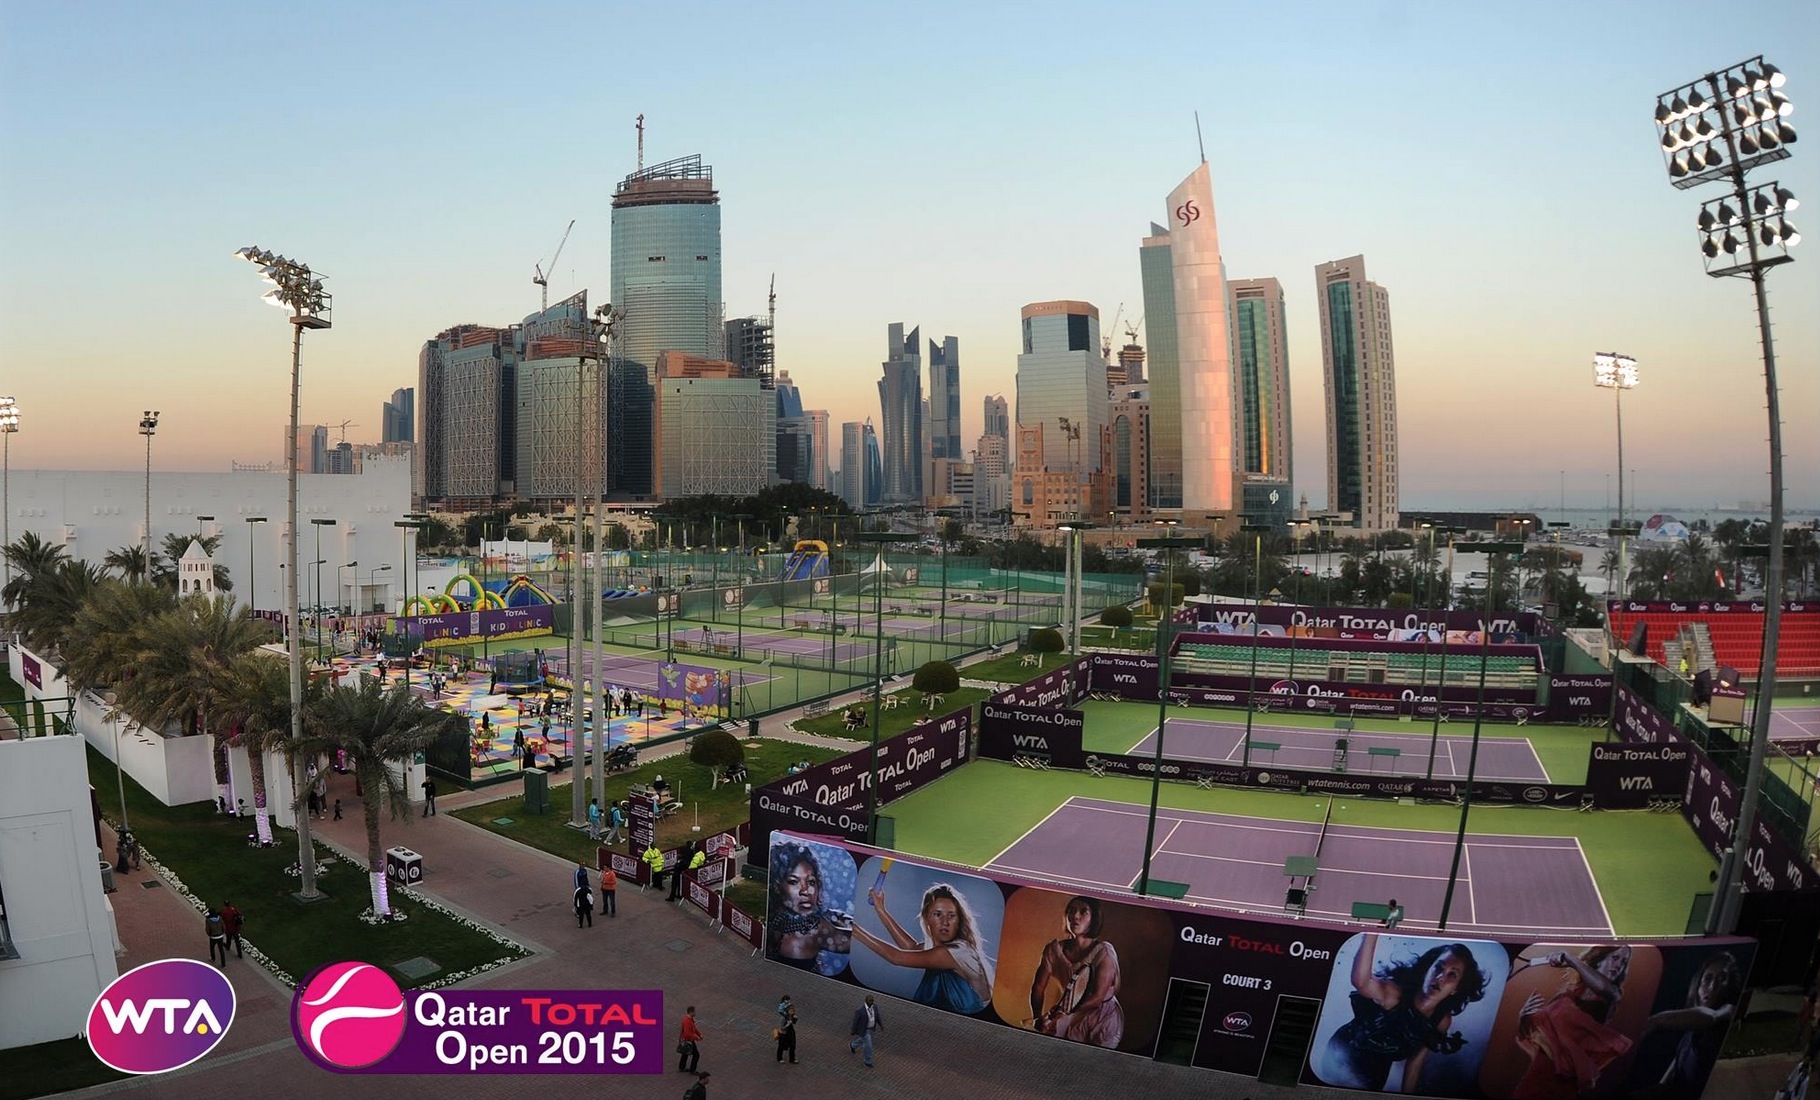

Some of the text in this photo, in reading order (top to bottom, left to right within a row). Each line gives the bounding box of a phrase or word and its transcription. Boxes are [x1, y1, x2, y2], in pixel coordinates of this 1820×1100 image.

[1291, 611, 1336, 628] Qatar
[1339, 615, 1395, 630] TOTAL
[1094, 656, 1112, 665] Qatar
[1140, 660, 1158, 668] Open
[1113, 674, 1137, 684] WTA
[1552, 679, 1569, 687] Qatar
[1595, 679, 1612, 688] Open
[1037, 687, 1061, 706] TOTAL
[1307, 685, 1345, 697] Qatar
[1569, 697, 1591, 705] WTA
[984, 706, 1082, 727] Qatar TOTAL Open
[940, 719, 957, 734] WTA
[907, 734, 924, 745] TOTAL
[1013, 734, 1048, 749] WTA
[1594, 747, 1687, 761] Qatar TOTAL Open
[815, 782, 855, 806] Qatar
[906, 747, 935, 771] Open
[831, 763, 853, 776] TOTAL
[783, 779, 808, 796] WTA
[894, 779, 912, 792] TOTAL
[1307, 779, 1370, 791] wtatennis.com
[1620, 777, 1653, 790] WTA
[759, 795, 791, 814] Qatar
[793, 805, 836, 826] TOTAL
[1710, 796, 1729, 834] Qatar
[1753, 848, 1775, 891] Open
[1787, 860, 1803, 889] WTA
[1180, 926, 1330, 960] Qatar TOTAL Open
[1222, 973, 1272, 990] COURT 3
[1226, 1016, 1249, 1026] WTA
